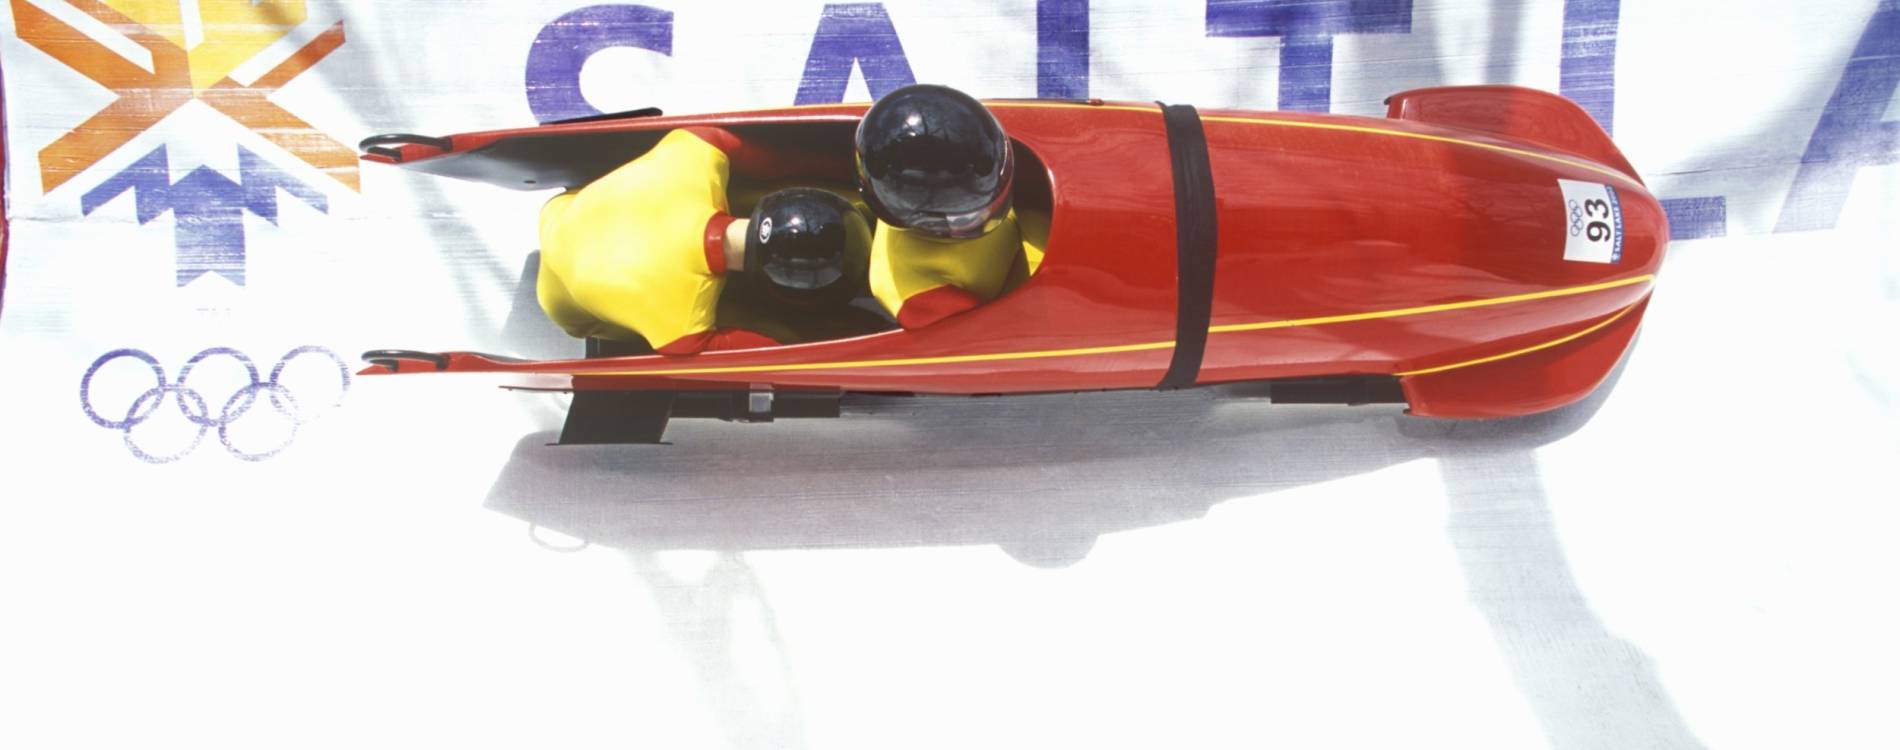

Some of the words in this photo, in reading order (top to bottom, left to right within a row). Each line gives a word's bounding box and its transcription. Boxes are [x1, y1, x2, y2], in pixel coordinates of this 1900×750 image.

[1584, 199, 1611, 242] 93
[1613, 206, 1622, 229] LAKE
[1613, 230, 1622, 253] SALT
